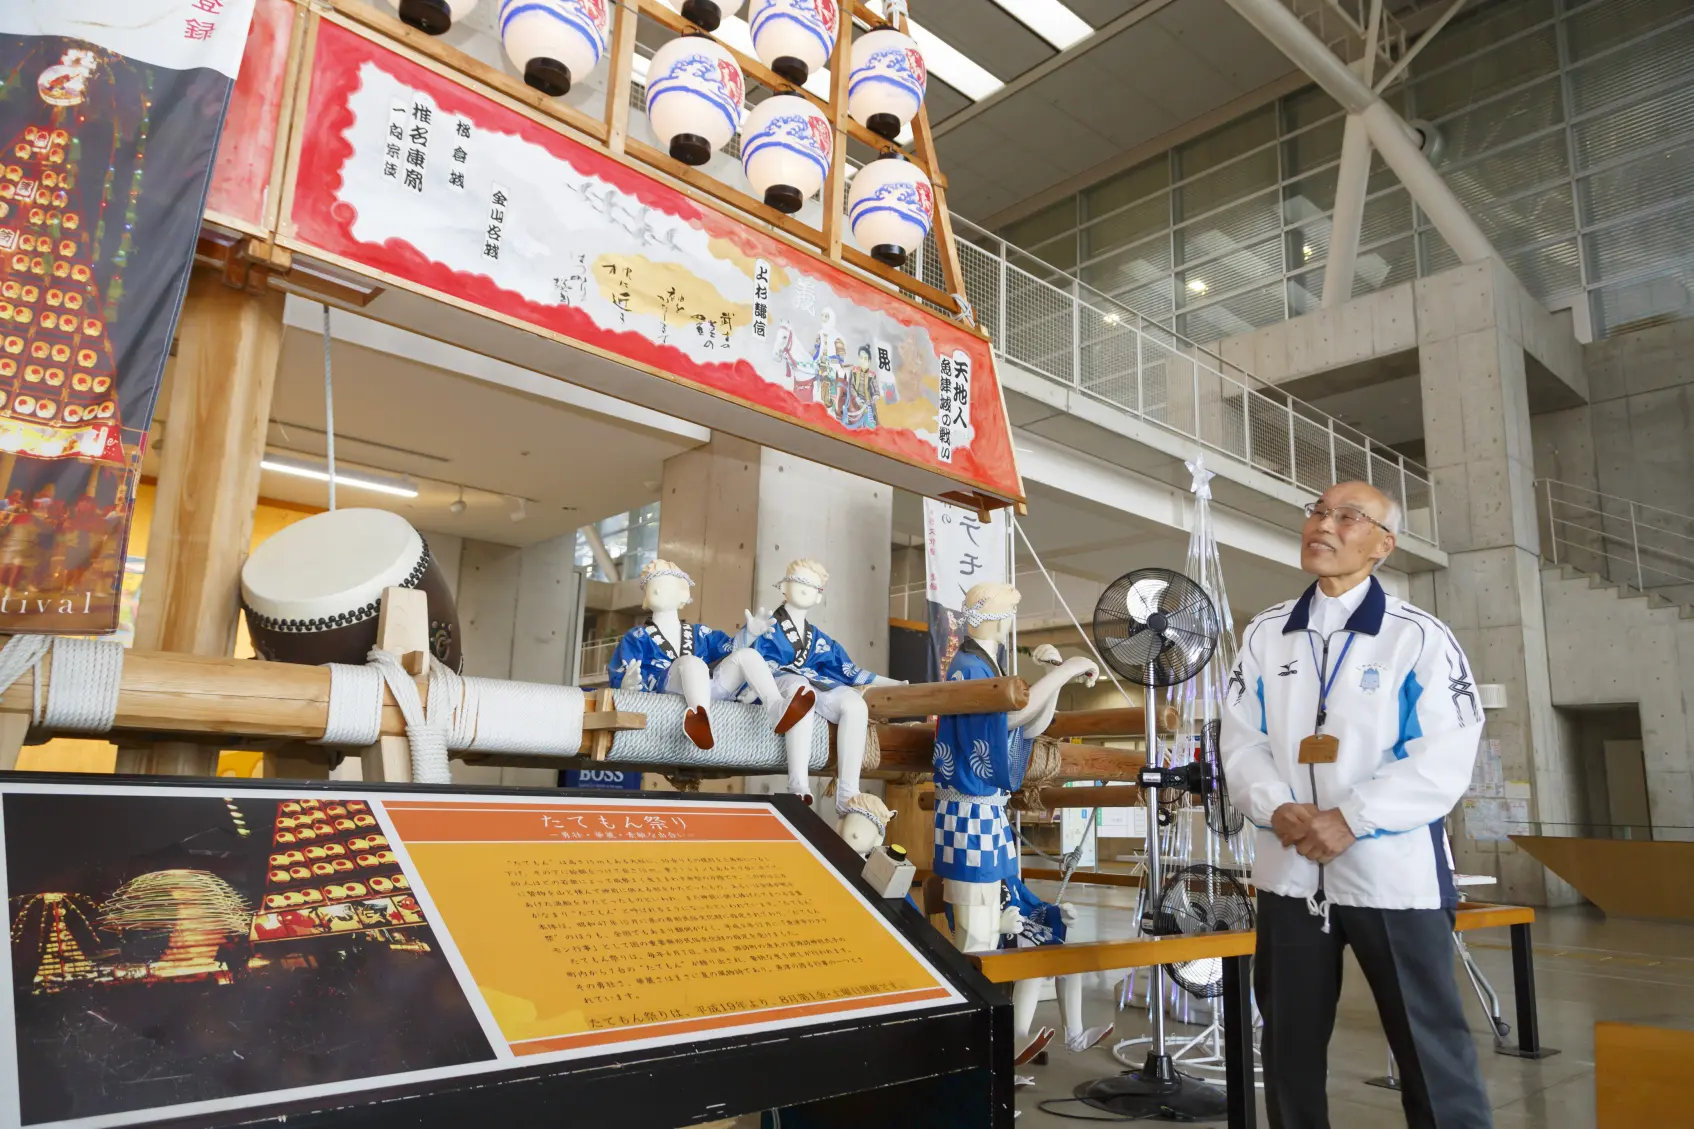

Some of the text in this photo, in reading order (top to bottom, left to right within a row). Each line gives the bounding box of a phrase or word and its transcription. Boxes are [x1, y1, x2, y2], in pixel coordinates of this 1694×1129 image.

[752, 265, 770, 338] 上杉謙信
[952, 360, 969, 429] 天地人
[541, 814, 687, 831] たてもん祭り
